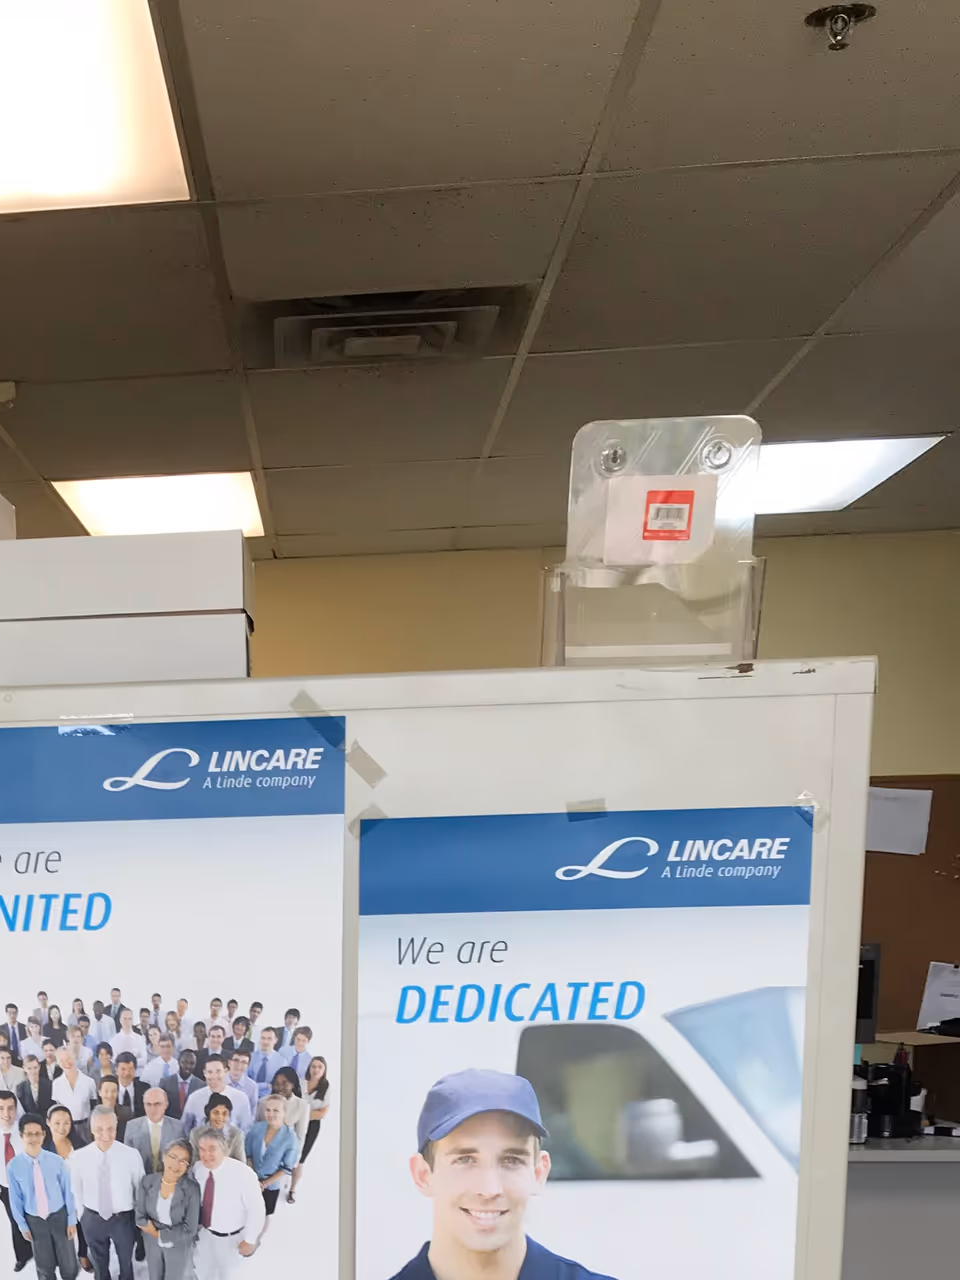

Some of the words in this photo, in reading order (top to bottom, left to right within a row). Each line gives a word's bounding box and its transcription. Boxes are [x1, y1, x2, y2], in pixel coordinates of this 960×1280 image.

[208, 748, 324, 773] LINCARE
[202, 778, 212, 789] A
[216, 775, 252, 789] Linde
[256, 776, 316, 790] company
[667, 837, 791, 862] LINCARE
[14, 850, 62, 875] are
[661, 866, 672, 878] A
[676, 864, 714, 878] Linde
[718, 865, 781, 880] company
[397, 937, 445, 965] We
[456, 941, 509, 964] are
[395, 981, 646, 1024] DEDICATED
